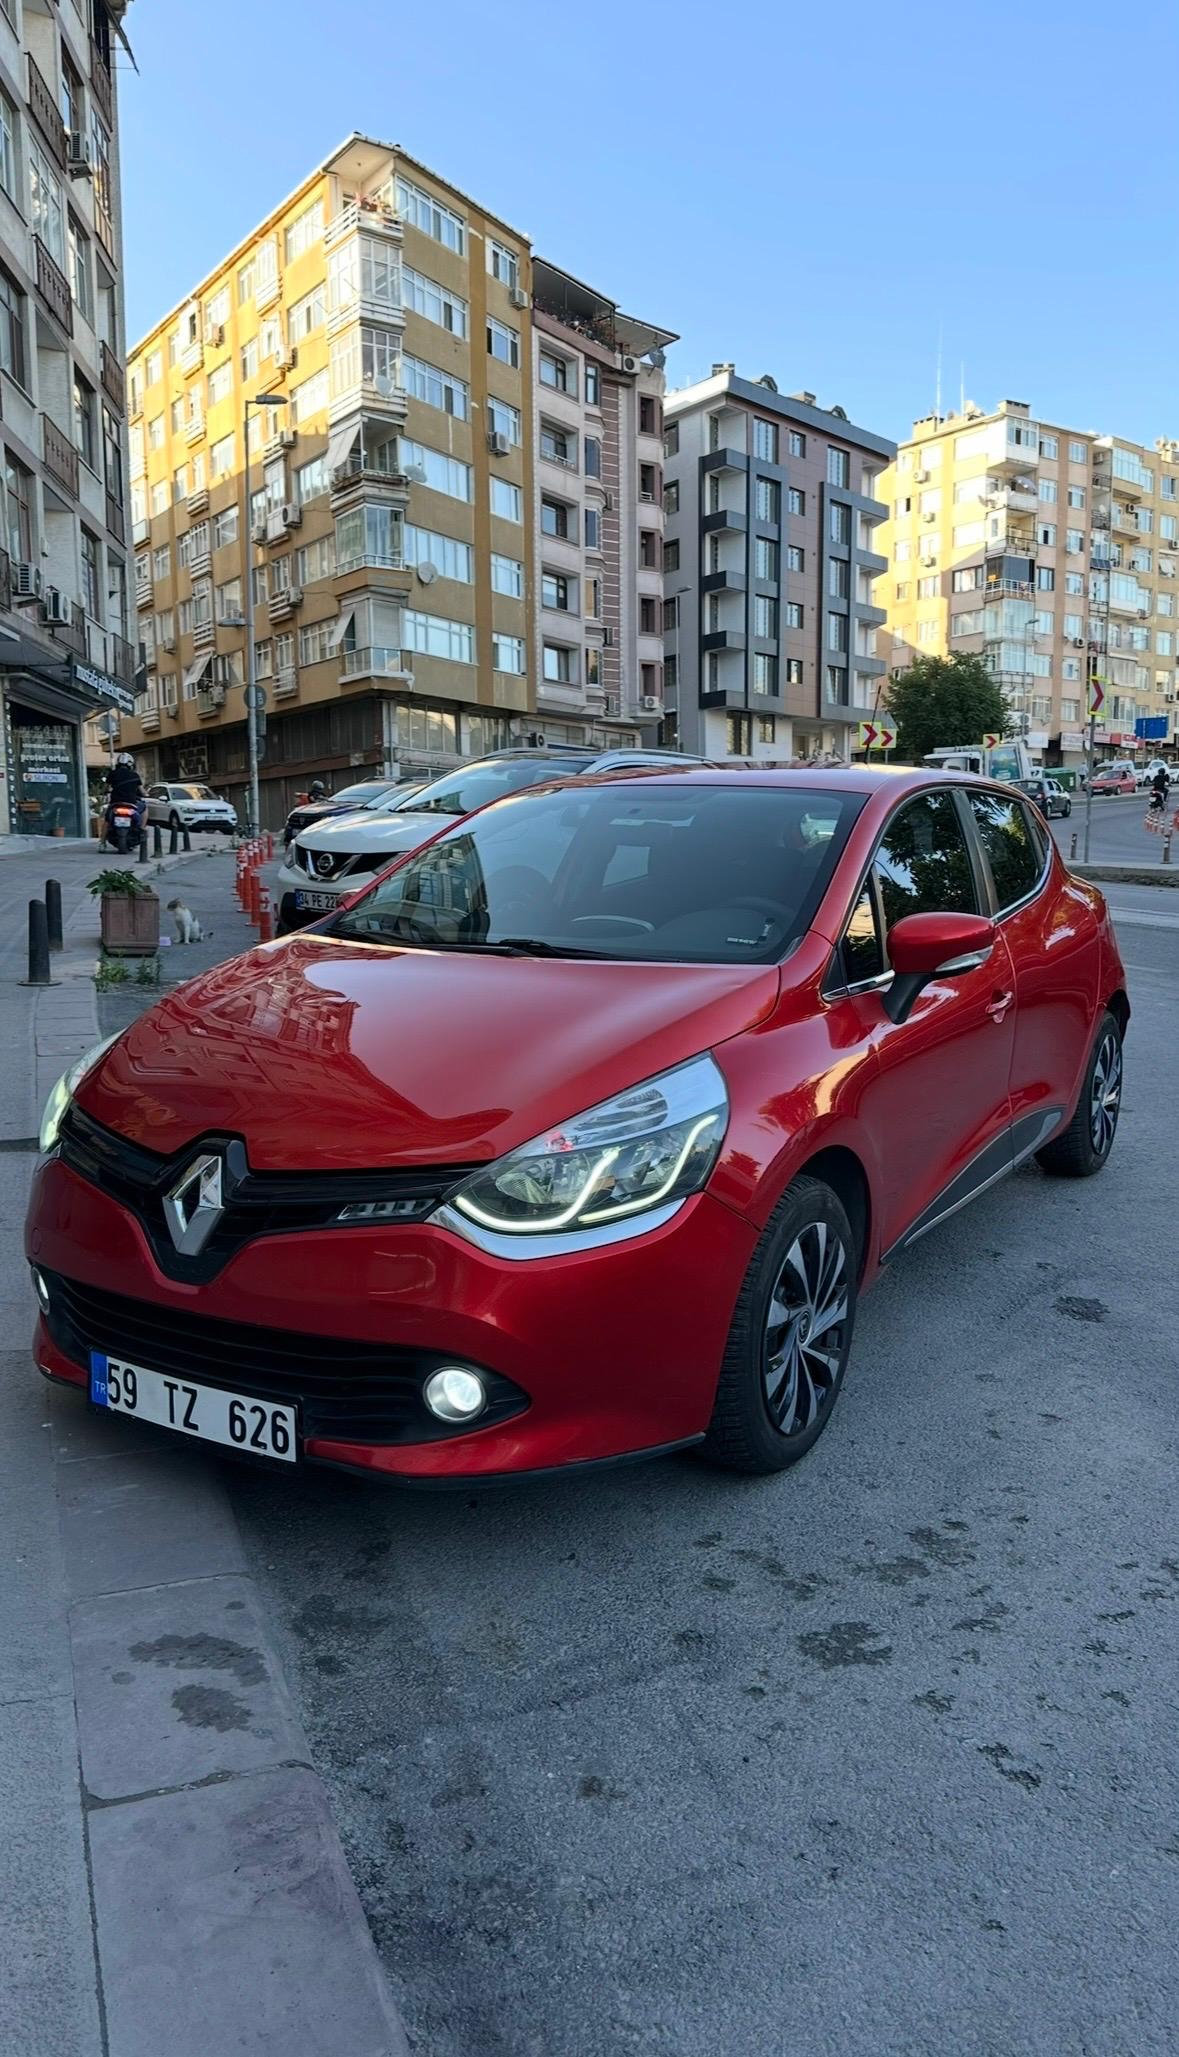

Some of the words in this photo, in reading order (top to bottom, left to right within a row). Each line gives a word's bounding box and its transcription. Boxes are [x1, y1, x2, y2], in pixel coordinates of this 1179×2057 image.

[311, 894, 323, 908] PE
[95, 1380, 106, 1395] TR
[108, 1362, 138, 1410] 59
[163, 1380, 199, 1431] TZ
[228, 1399, 290, 1455] 626
